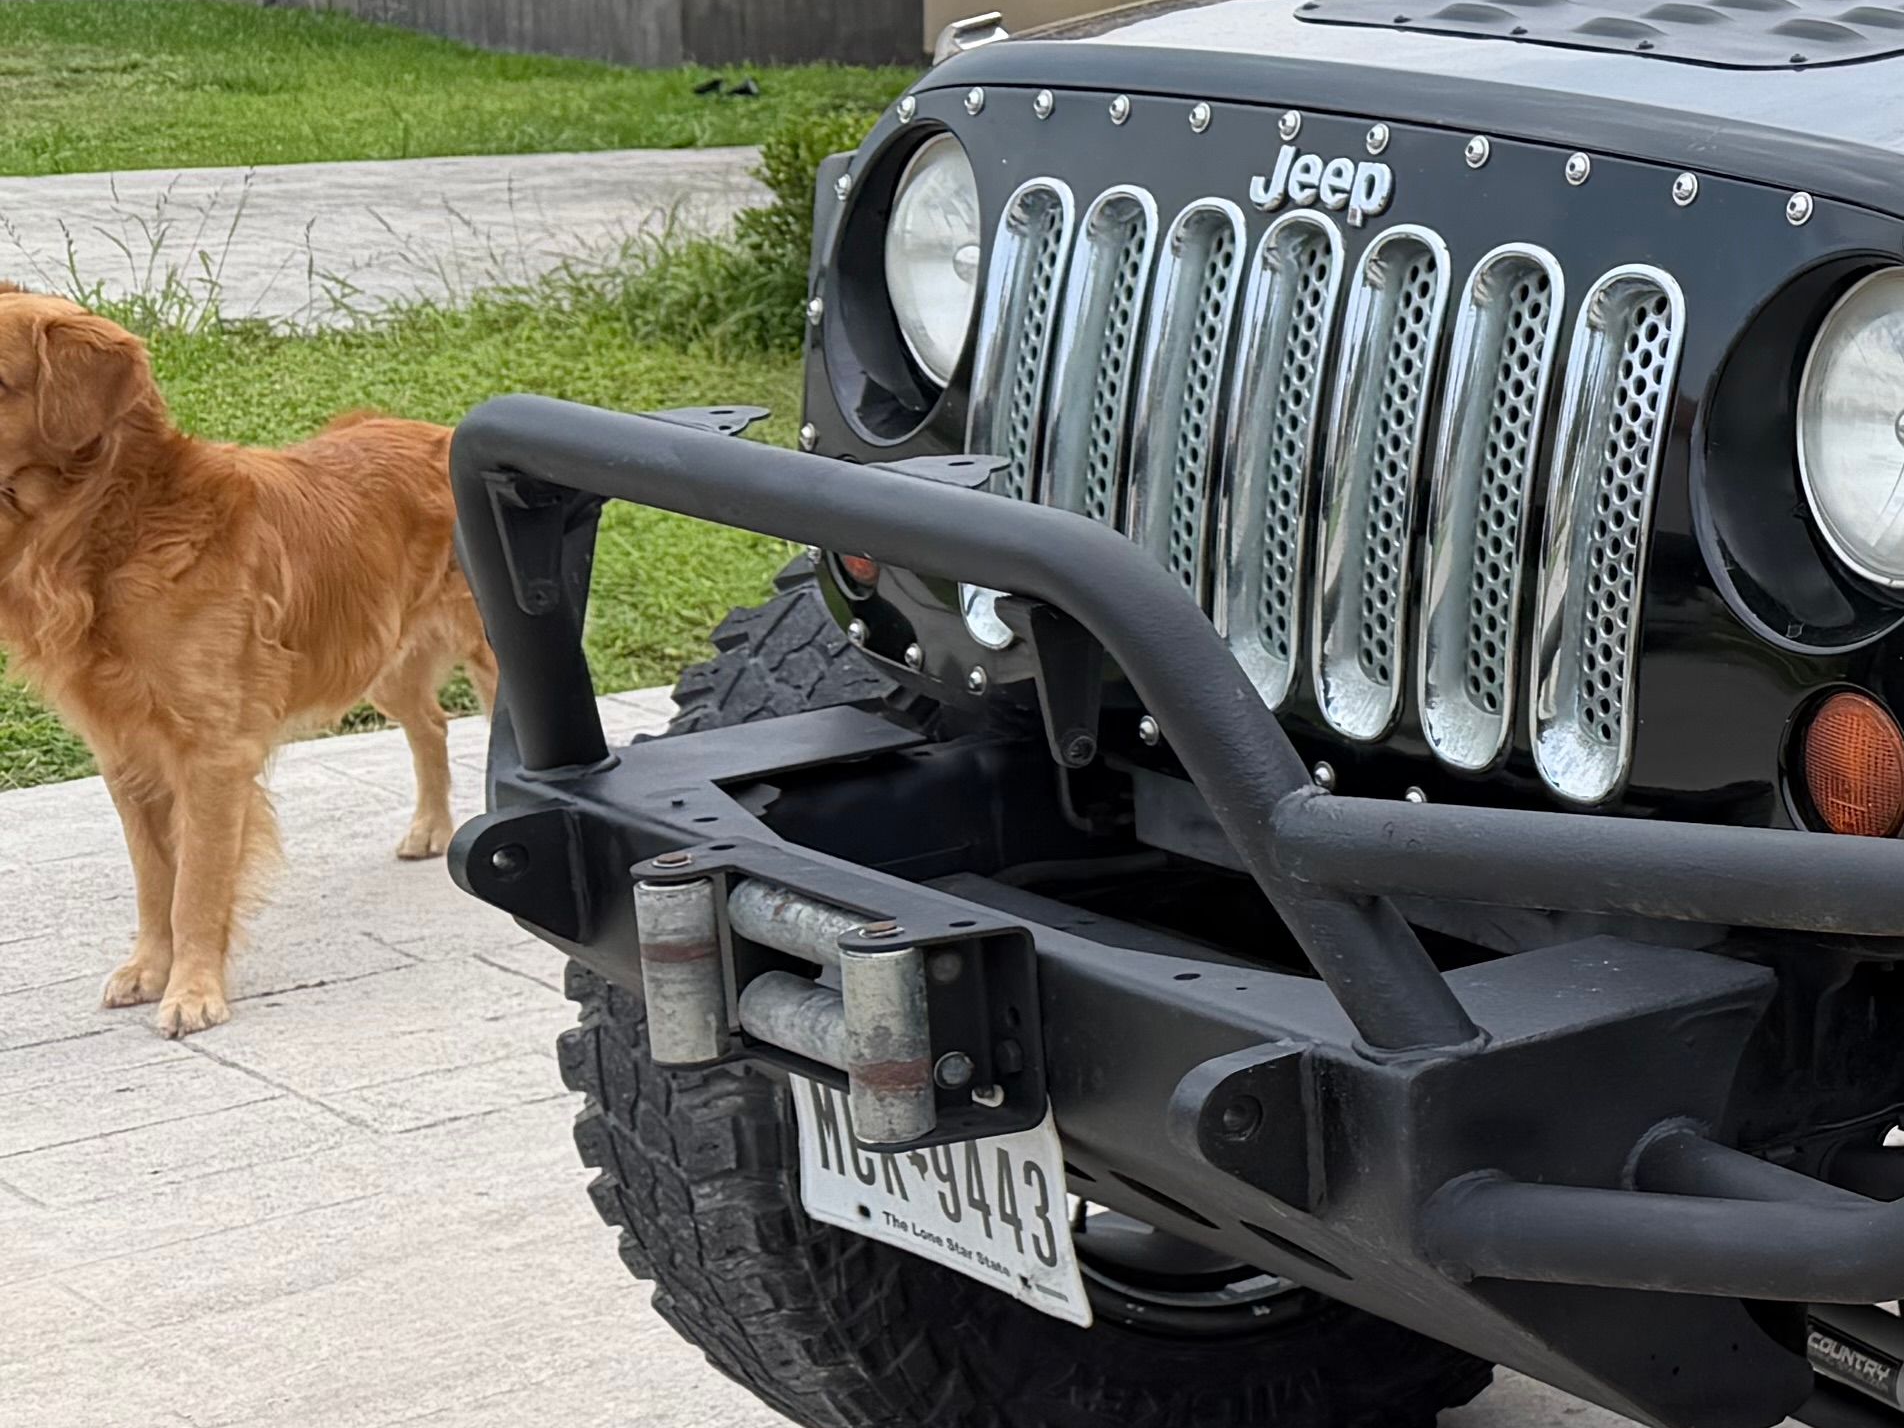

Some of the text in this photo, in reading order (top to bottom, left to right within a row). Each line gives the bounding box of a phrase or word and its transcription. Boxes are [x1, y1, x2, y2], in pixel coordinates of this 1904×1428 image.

[1249, 144, 1395, 228] Jeep
[930, 1139, 1058, 1269] 9443
[883, 1210, 1012, 1278] The Lone Star State
[1807, 1331, 1891, 1382] COUNTRY
